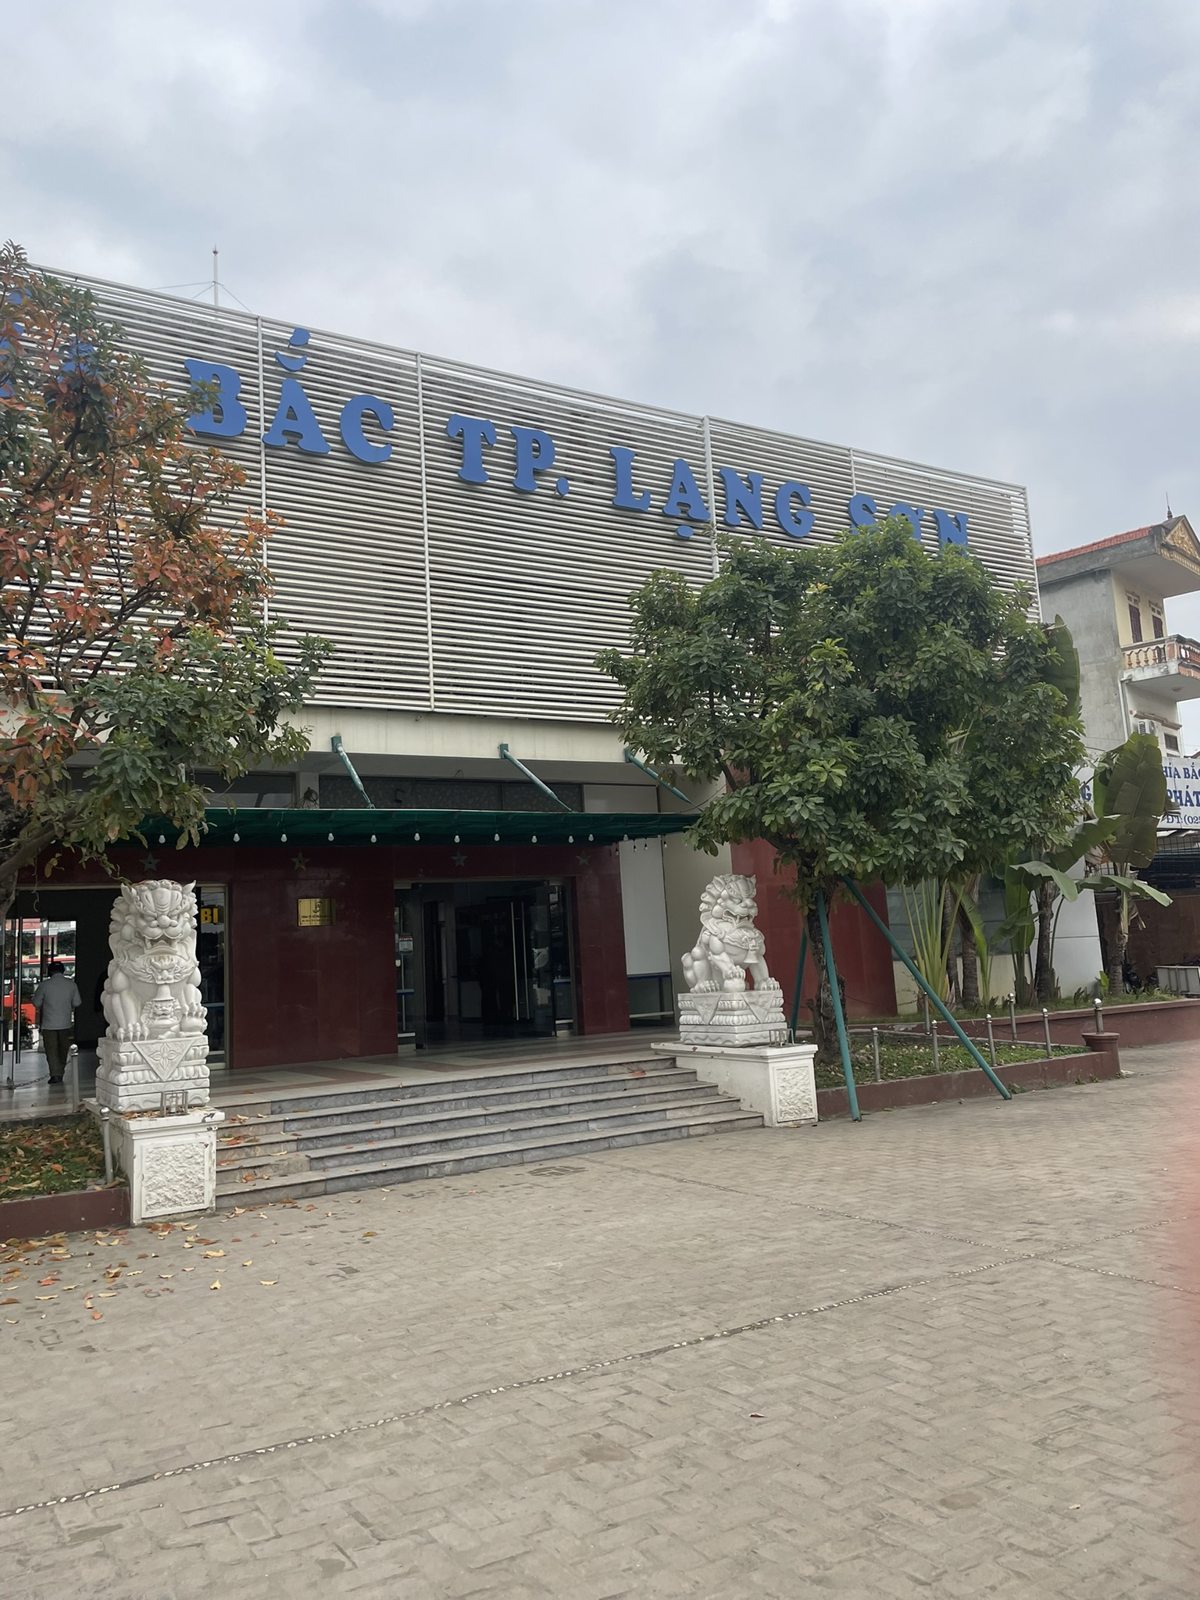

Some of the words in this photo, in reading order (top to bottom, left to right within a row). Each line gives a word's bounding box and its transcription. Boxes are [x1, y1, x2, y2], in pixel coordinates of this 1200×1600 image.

[184, 327, 395, 464] BẮC
[446, 413, 570, 496] TP.
[609, 447, 816, 538] LẠNG
